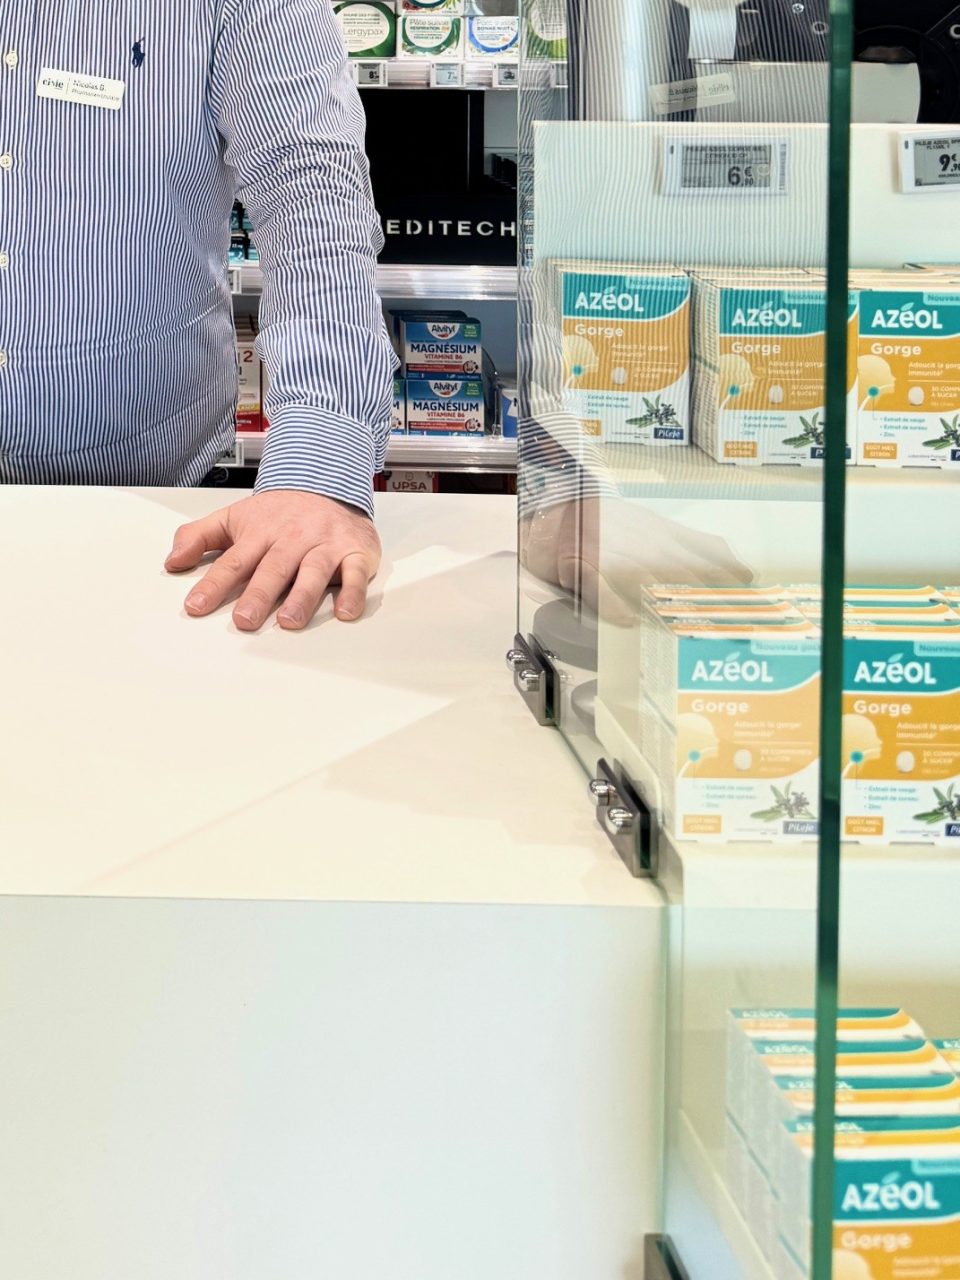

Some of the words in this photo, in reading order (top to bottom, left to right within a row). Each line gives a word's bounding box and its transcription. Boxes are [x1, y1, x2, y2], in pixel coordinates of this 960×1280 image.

[342, 26, 384, 37] Lergypax
[386, 219, 517, 236] EDITECH
[431, 323, 457, 335] Alvityl
[574, 323, 625, 338] Gorge
[410, 341, 477, 354] MAGNÉSIUM
[731, 342, 781, 356] Gorge
[870, 342, 922, 357] Gorge
[432, 380, 458, 392] Alvityl
[412, 399, 479, 412] MAGNÉSIUM
[392, 481, 427, 492] UPSA
[691, 698, 750, 715] Gorge
[853, 699, 912, 717] Gorge
[841, 1230, 913, 1252] Gorge
